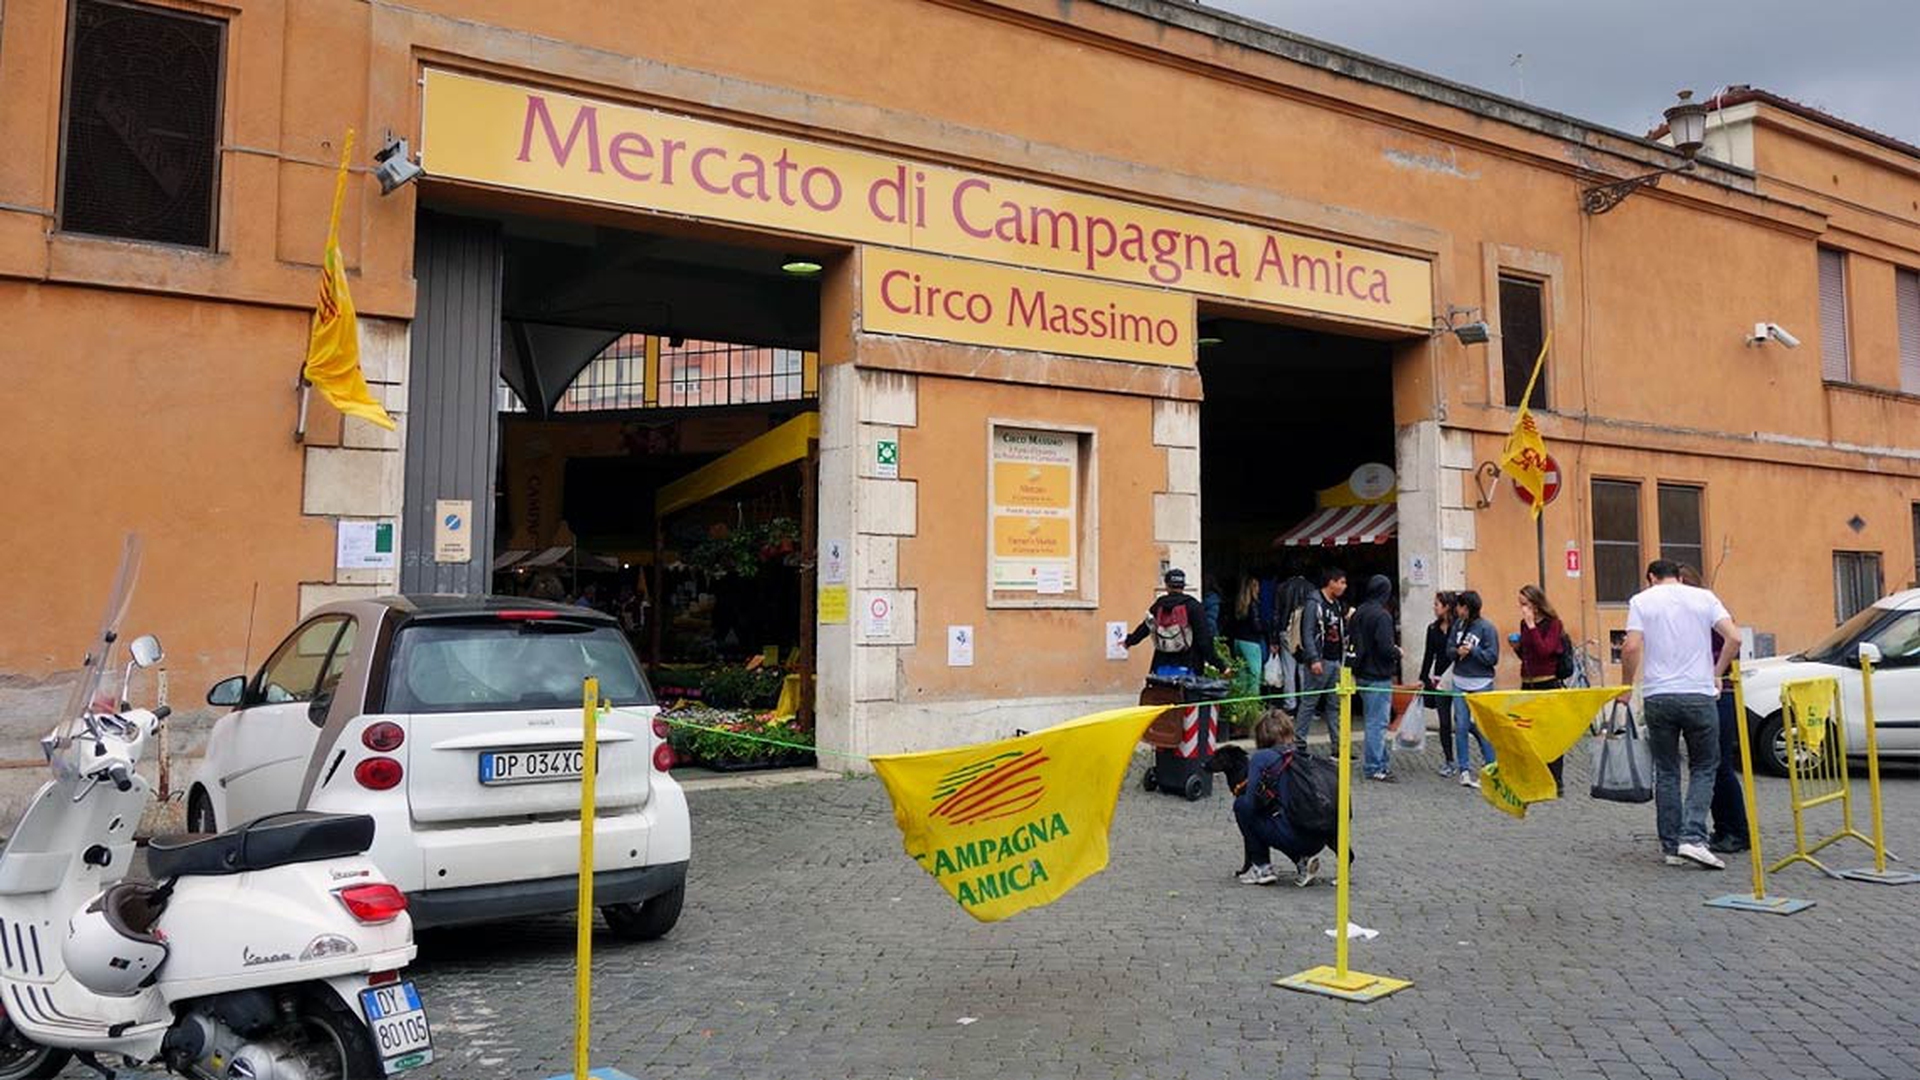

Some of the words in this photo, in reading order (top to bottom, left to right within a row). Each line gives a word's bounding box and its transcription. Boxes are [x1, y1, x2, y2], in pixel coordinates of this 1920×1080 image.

[516, 95, 842, 213] Mercato
[868, 165, 928, 228] di
[952, 178, 1239, 285] Campagna
[1255, 234, 1391, 304] Amica
[880, 268, 993, 324] Circo
[1008, 286, 1179, 347] Massimo
[496, 755, 518, 777] DP
[526, 752, 584, 775] 034XC
[956, 858, 1048, 906] AMICA
[377, 988, 399, 1015] DY
[378, 1015, 427, 1050] 80105
